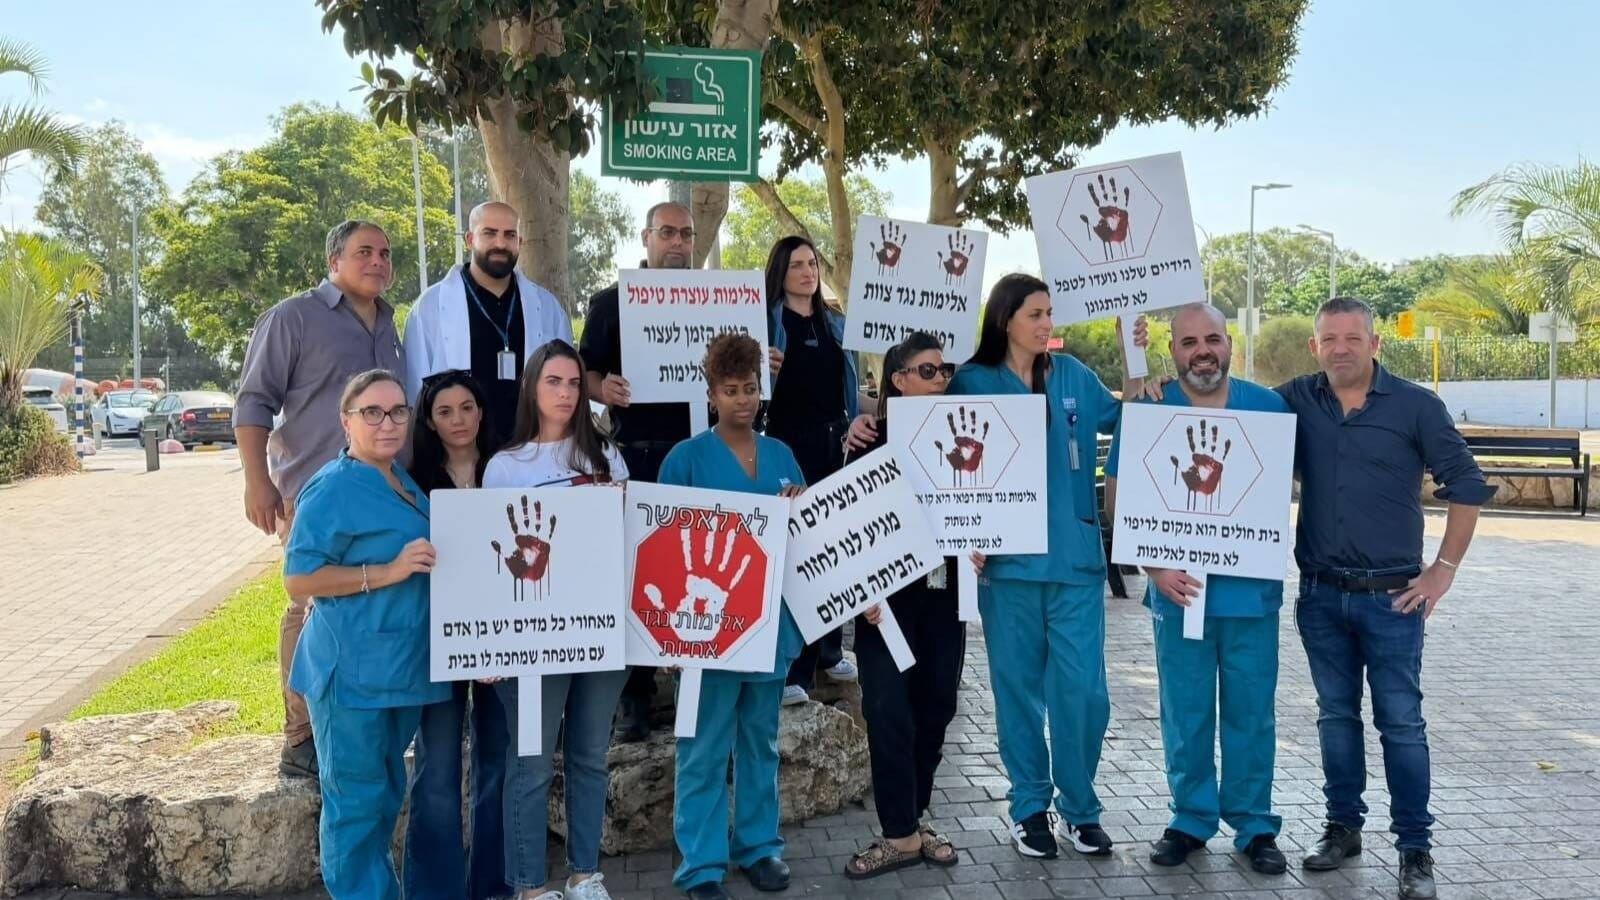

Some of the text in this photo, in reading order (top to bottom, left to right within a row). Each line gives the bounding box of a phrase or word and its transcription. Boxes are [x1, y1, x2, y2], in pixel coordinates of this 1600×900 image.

[624, 120, 736, 140] אזור עישון
[624, 143, 736, 162] SMOKING AREA
[1055, 258, 1192, 293] הידיים שלנו נועדו לטפל
[628, 282, 760, 305] אלימות עוצרת טיפול
[864, 282, 968, 312] אלימות נגד צוות
[1084, 290, 1148, 316] לא להתגונן
[644, 321, 680, 344] לעצור
[864, 321, 896, 342] אדום
[856, 458, 902, 496] אנחנו
[800, 484, 858, 528] מצילים
[936, 493, 950, 504] היא
[952, 492, 974, 504] רפואי
[976, 492, 992, 502] צוות
[994, 492, 1006, 502] נגד
[1008, 490, 1036, 502] אלימות
[636, 502, 768, 536] לא לאפשר
[944, 512, 982, 529] לא נשתוק
[1123, 514, 1280, 542] בית חולים הוא מקום לריפוי
[796, 511, 901, 582] מגיע לנו לחזור
[948, 536, 967, 549] לסדר
[969, 537, 990, 548] נעבור
[992, 534, 1002, 548] לא
[1136, 543, 1239, 566] לא מקום לאלימות
[816, 582, 868, 624] בשלום
[443, 613, 616, 639] מאחורי כל מדים יש בן אדם
[638, 608, 746, 632] אלימות נגד
[448, 645, 605, 670] עם משפחה שמחכה לו בבית
[658, 640, 719, 659] אחיות
